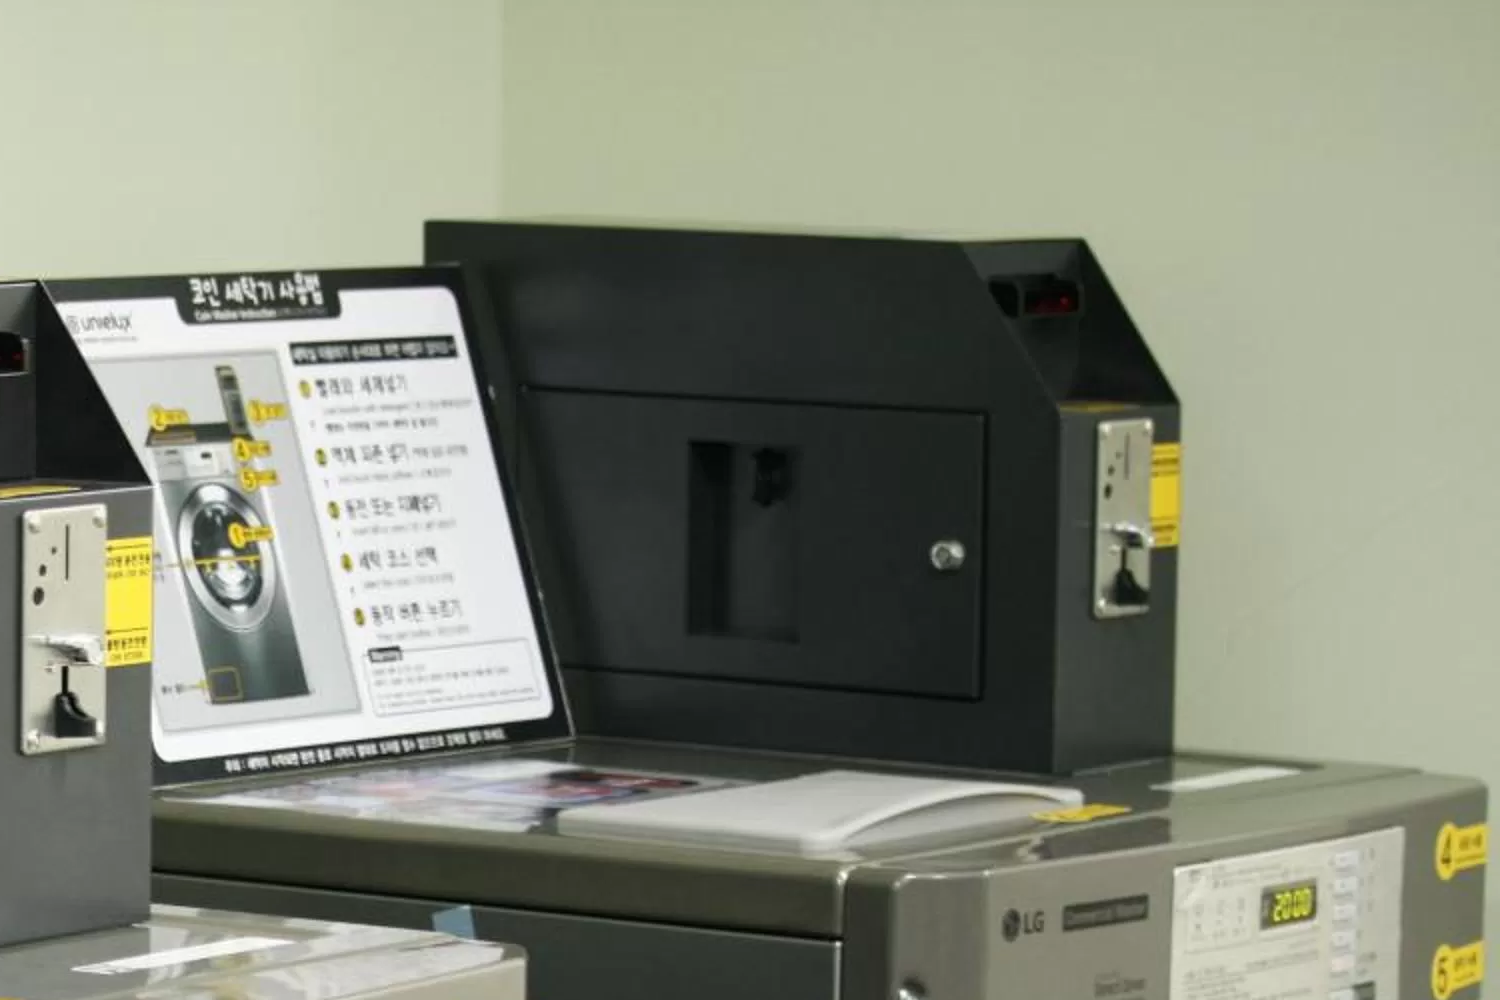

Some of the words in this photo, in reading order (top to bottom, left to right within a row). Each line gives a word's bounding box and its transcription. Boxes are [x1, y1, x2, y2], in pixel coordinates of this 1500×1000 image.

[188, 278, 221, 307] 코인
[225, 276, 276, 305] 세탁기
[279, 272, 324, 306] 사용법
[1023, 908, 1045, 935] LG
